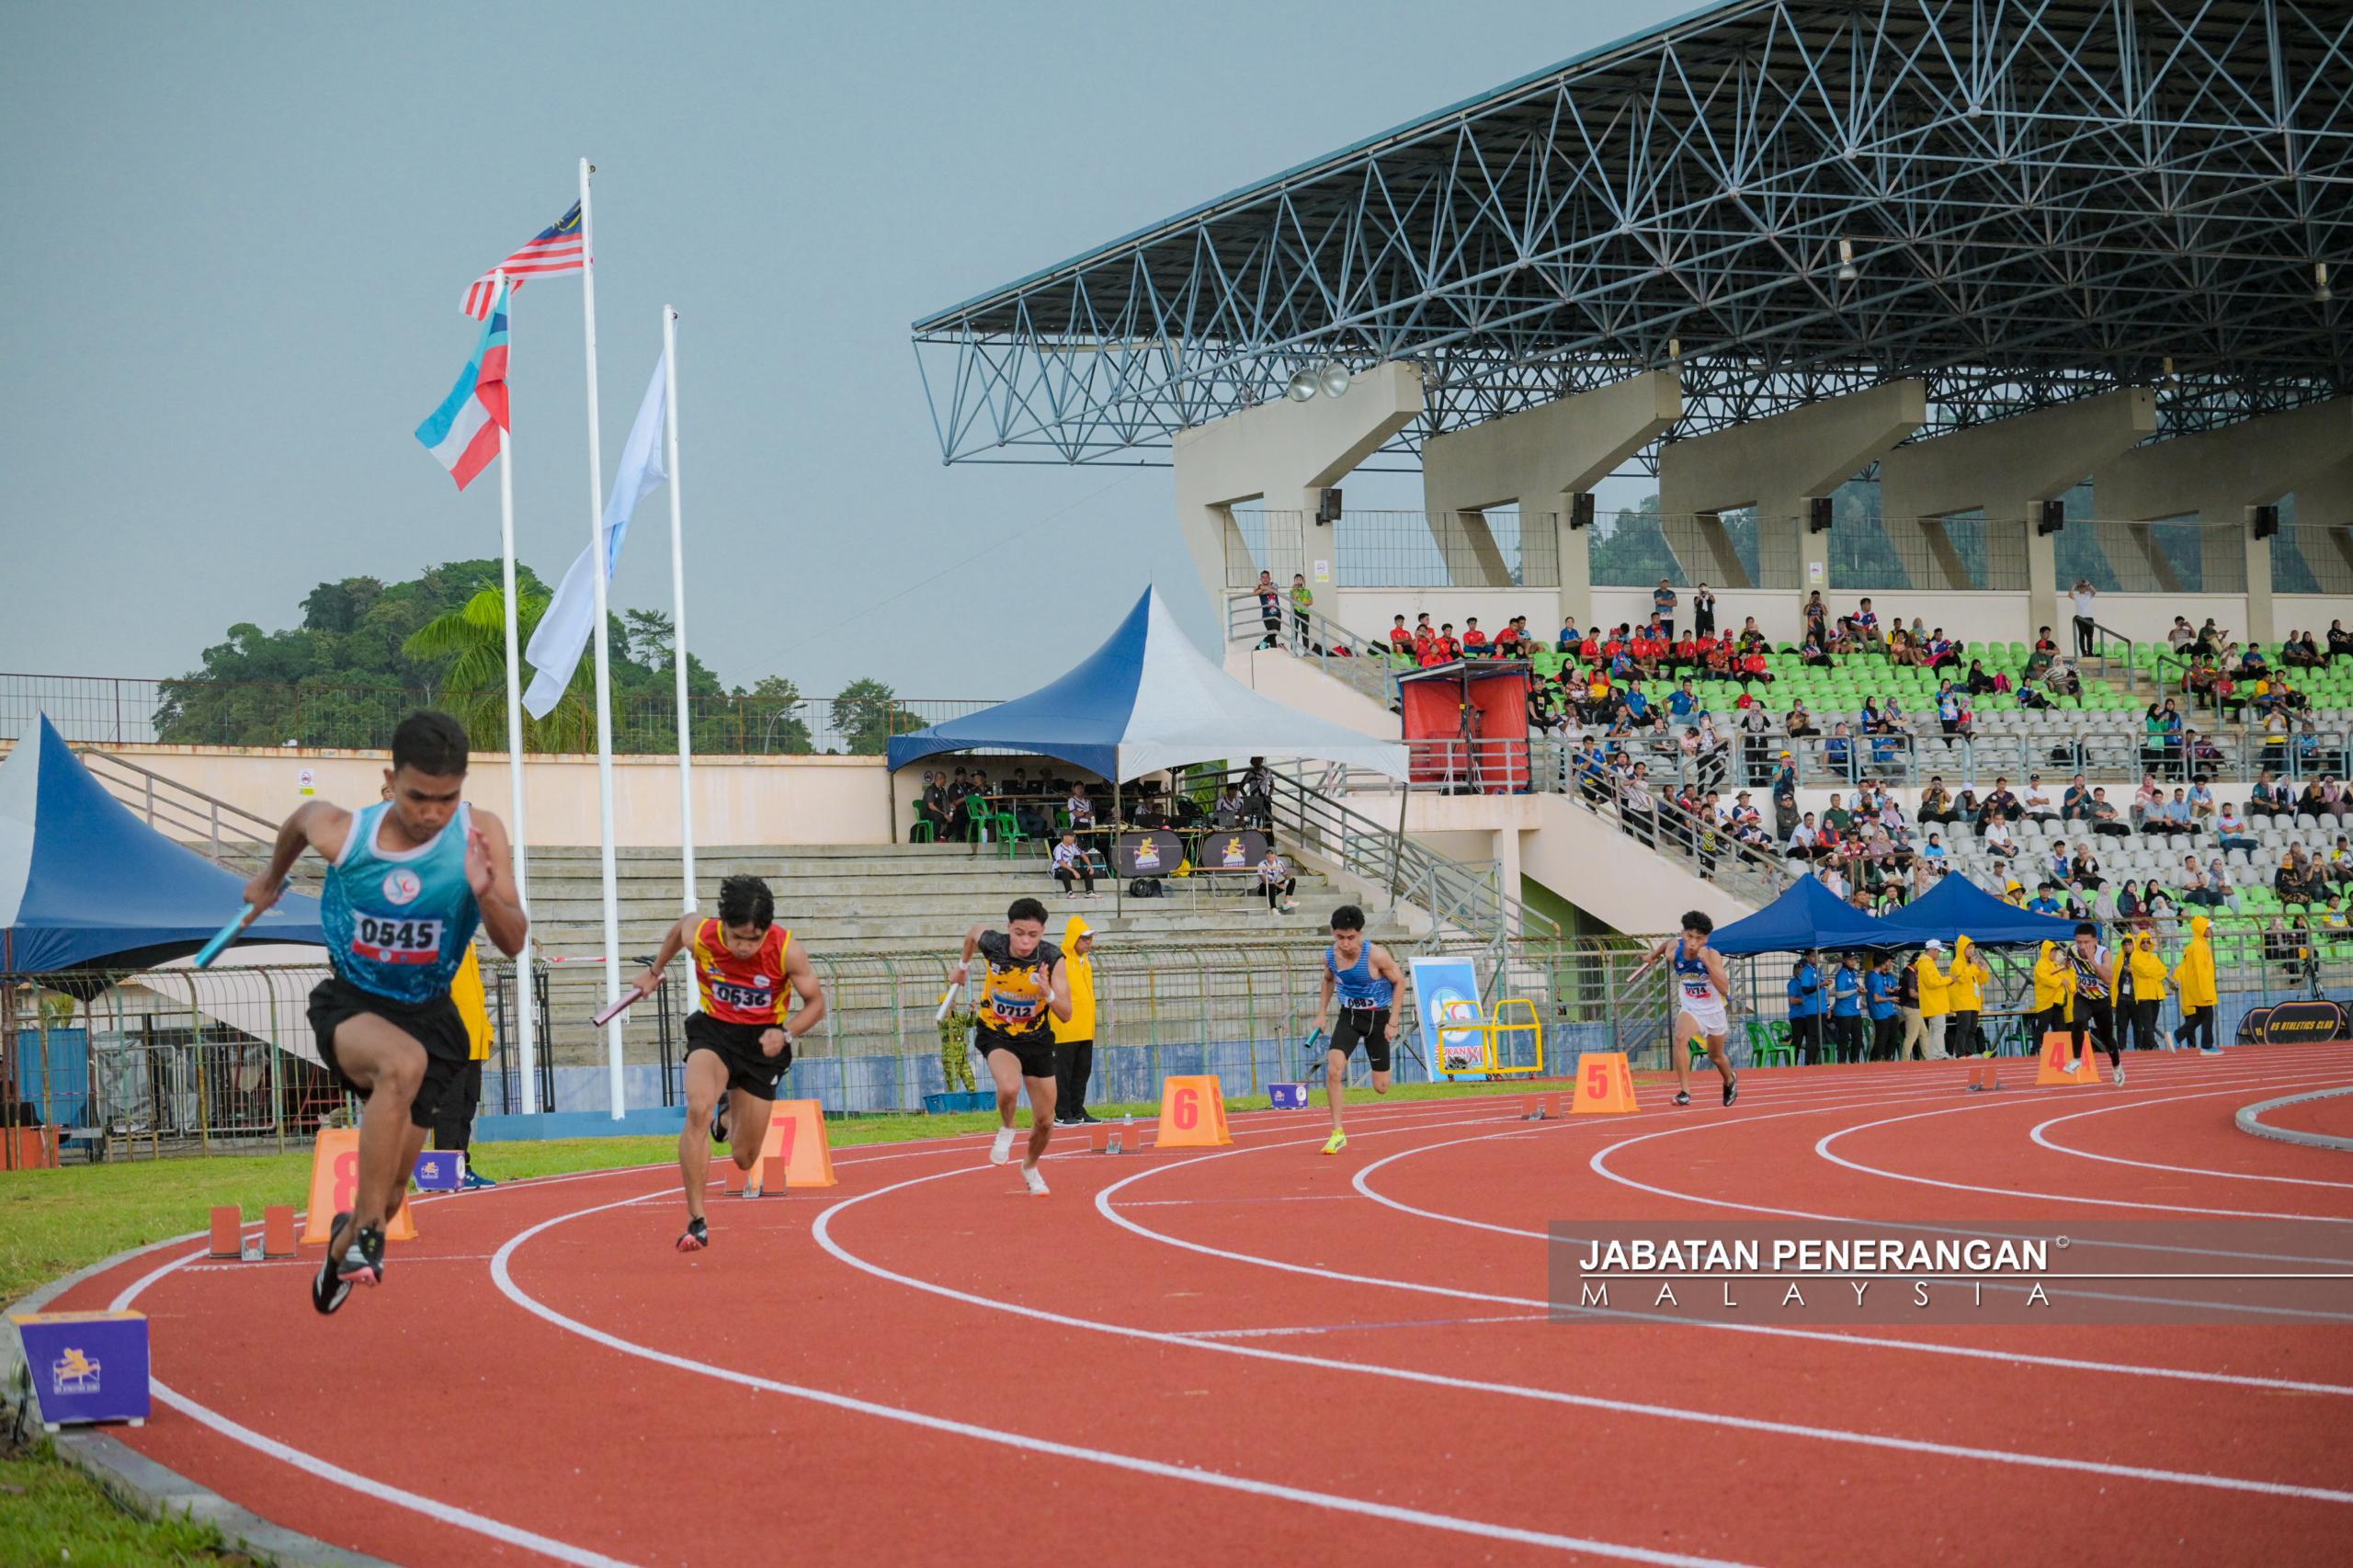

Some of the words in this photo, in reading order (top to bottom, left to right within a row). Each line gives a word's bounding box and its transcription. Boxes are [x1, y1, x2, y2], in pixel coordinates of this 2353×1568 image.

[361, 919, 434, 949] 0545
[996, 1003, 1031, 1017] 0712
[2049, 1042, 2067, 1073] 4
[1587, 1064, 1608, 1100] 5
[1174, 1088, 1199, 1131] 6
[771, 1116, 797, 1167] 7
